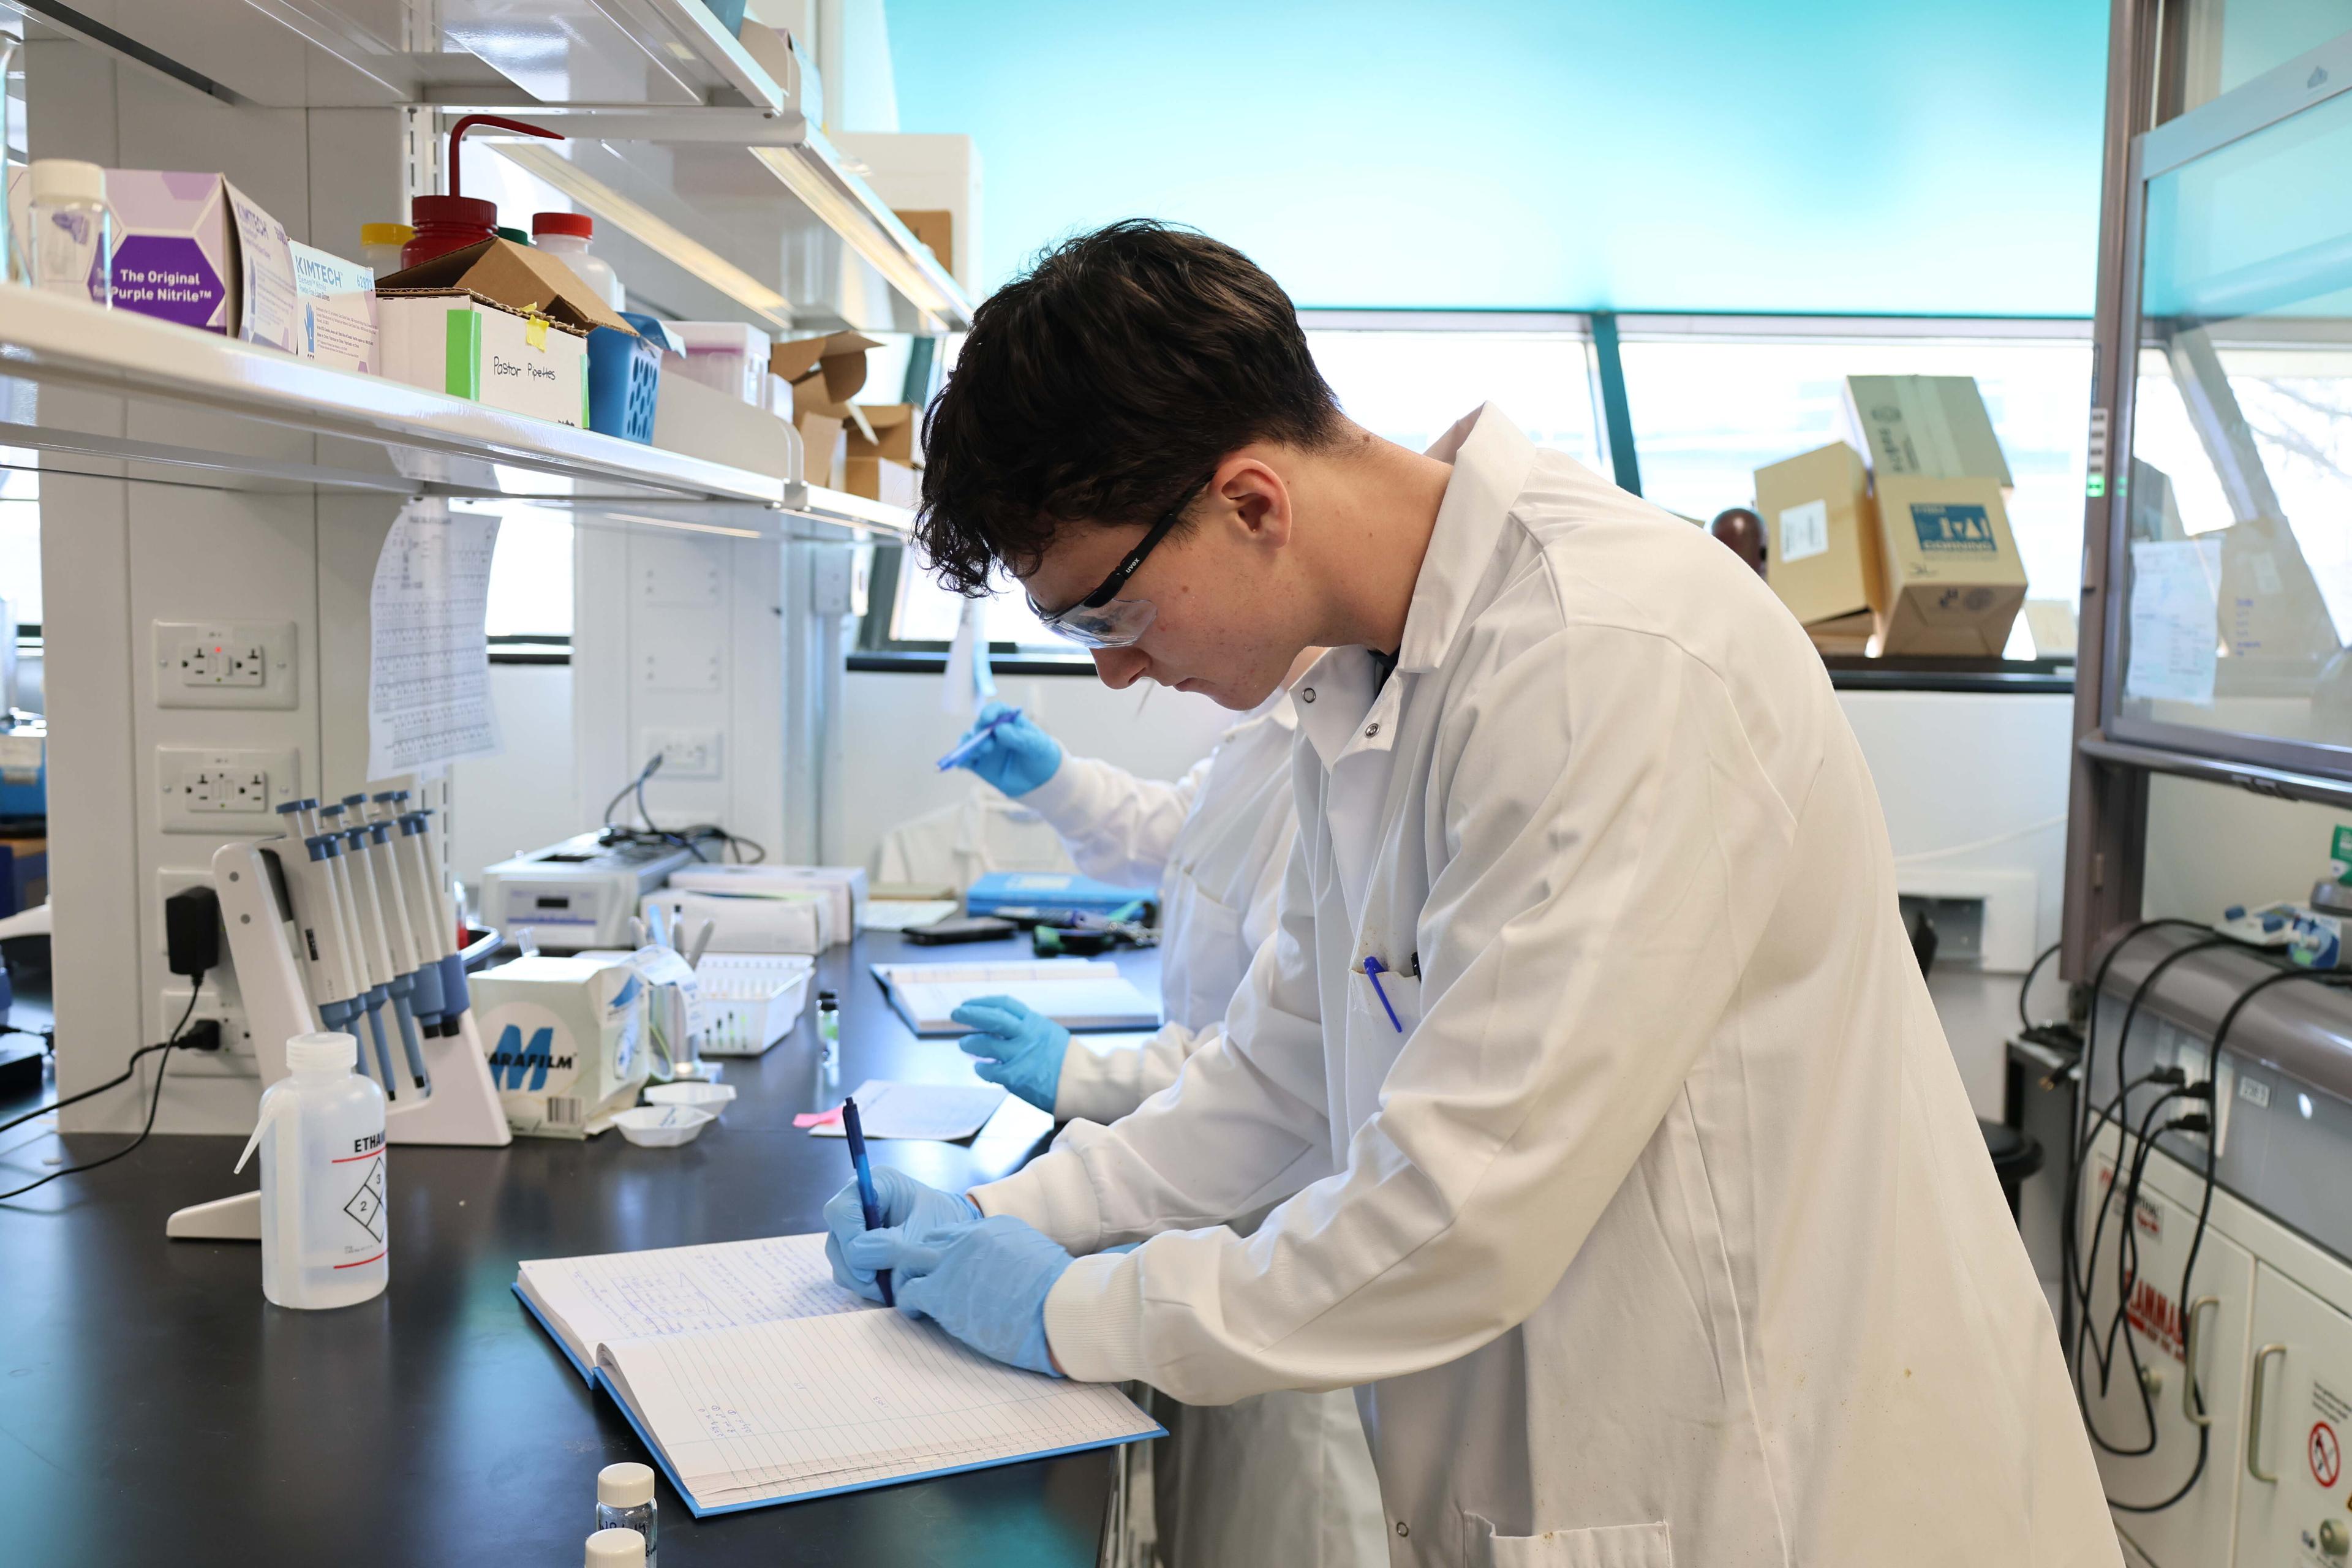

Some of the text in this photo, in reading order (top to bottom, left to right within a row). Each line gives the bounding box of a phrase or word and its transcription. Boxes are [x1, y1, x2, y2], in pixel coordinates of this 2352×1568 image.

[120, 269, 145, 282] The
[148, 270, 200, 286] Original
[111, 285, 154, 302] Purple
[494, 356, 522, 377] Pastor
[1125, 557, 1140, 573] uvex
[486, 1052, 573, 1069] ARAFILM
[376, 1174, 381, 1185] 3
[360, 1201, 368, 1212] 2
